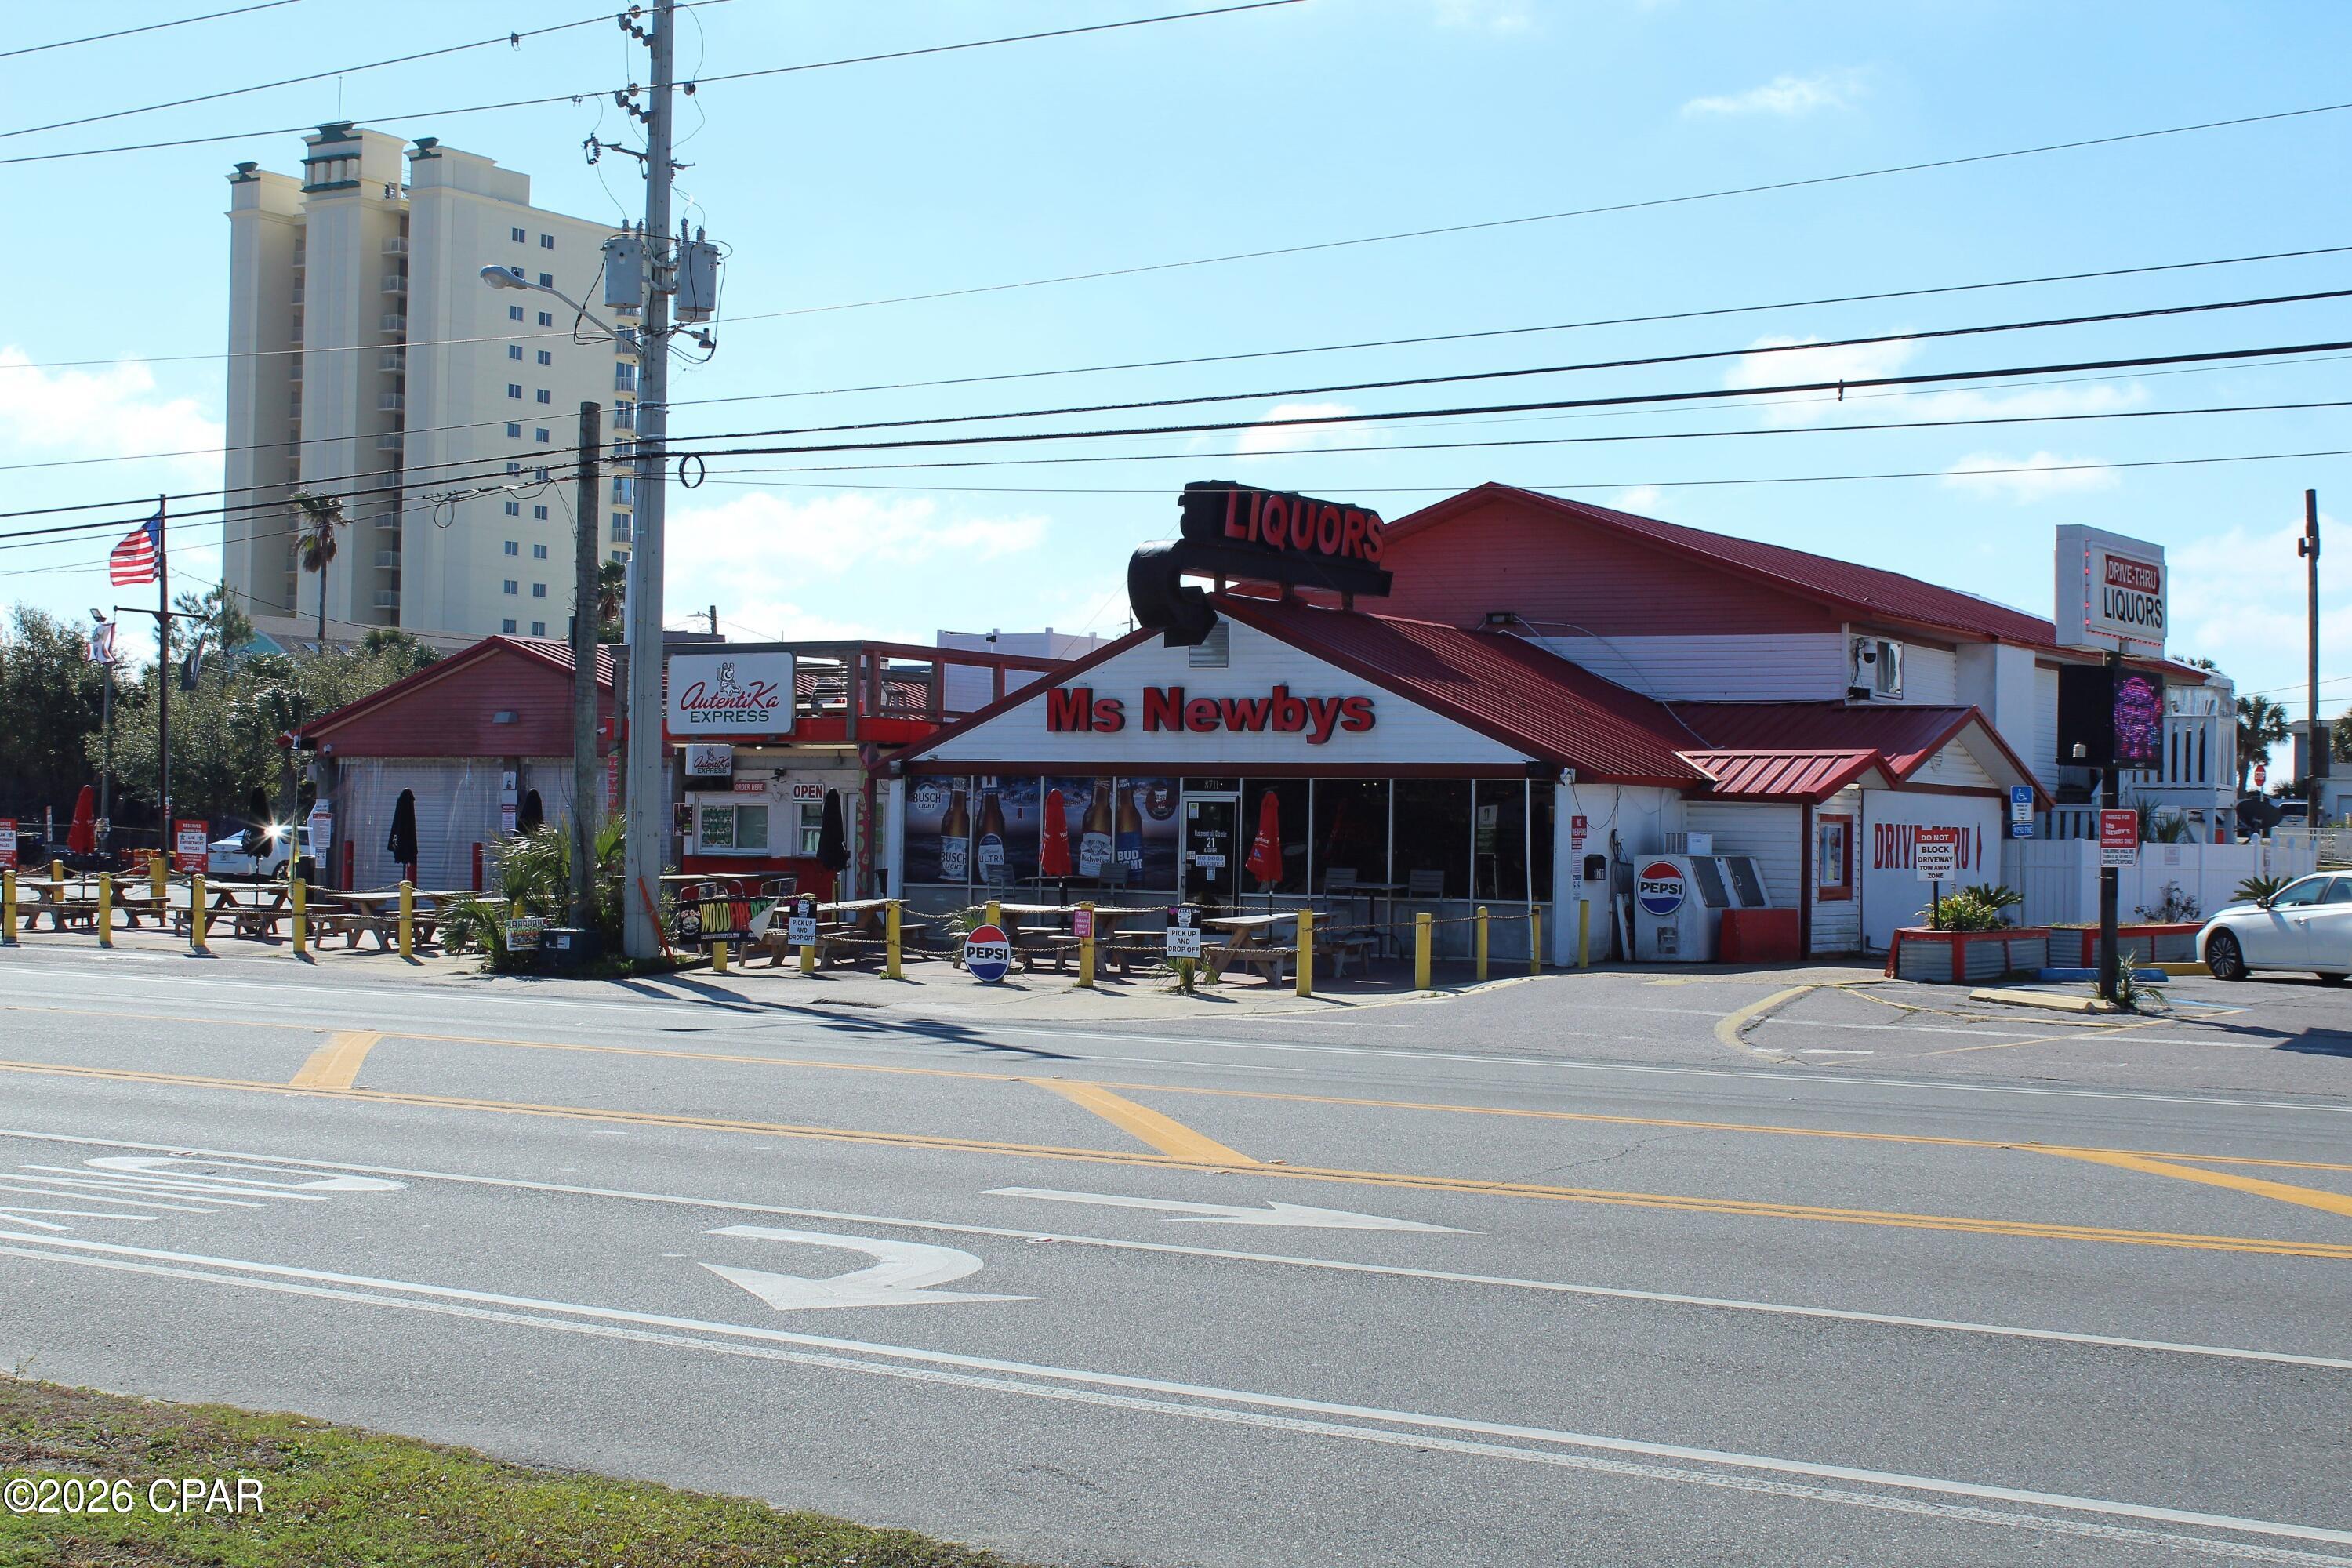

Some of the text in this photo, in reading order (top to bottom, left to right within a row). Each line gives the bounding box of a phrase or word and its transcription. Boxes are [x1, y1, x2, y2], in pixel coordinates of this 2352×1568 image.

[1225, 485, 1385, 563] LIQUORS
[2108, 561, 2156, 590] DRIVE-THRU
[2103, 587, 2163, 629] LIQUORS
[680, 681, 780, 710] AutentiKa
[690, 710, 769, 723] EXPRESS
[1047, 684, 1376, 745] Ms Newbys
[694, 756, 731, 768] AutentiKa
[1204, 780, 1219, 789] 8711
[793, 785, 823, 798] OPEN
[912, 793, 941, 803] BUSCH
[1207, 837, 1214, 848] 21
[941, 851, 967, 864] BUSCH
[979, 855, 1004, 863] ULTRA
[1117, 850, 1139, 861] BUD
[1640, 882, 1682, 895] PEPSI
[699, 902, 731, 933] WOOD
[967, 946, 1008, 960] PEPSI
